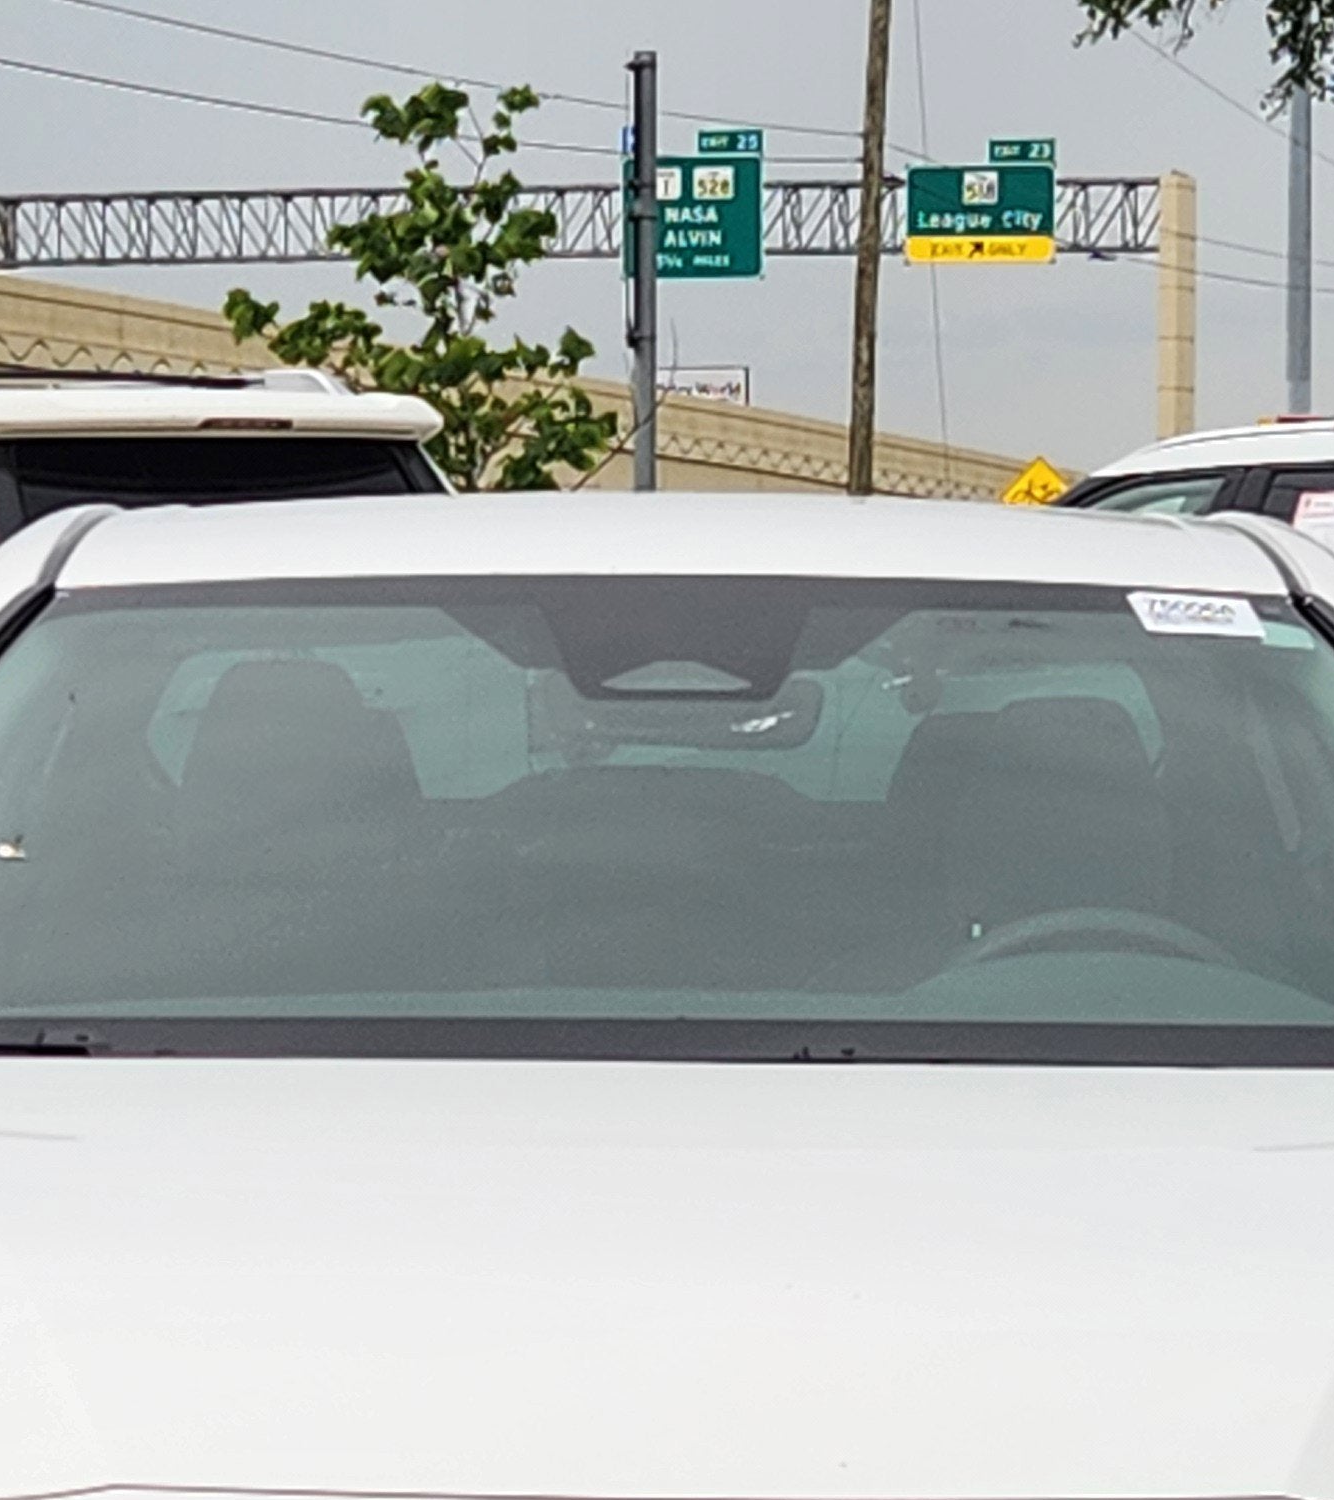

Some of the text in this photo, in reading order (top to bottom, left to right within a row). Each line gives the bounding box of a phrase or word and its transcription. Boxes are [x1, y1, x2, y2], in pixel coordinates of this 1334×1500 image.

[1027, 143, 1051, 159] 23
[663, 205, 719, 224] NASA
[916, 209, 1044, 233] League City
[663, 230, 722, 248] ALVIN
[987, 242, 1027, 257] ONLY
